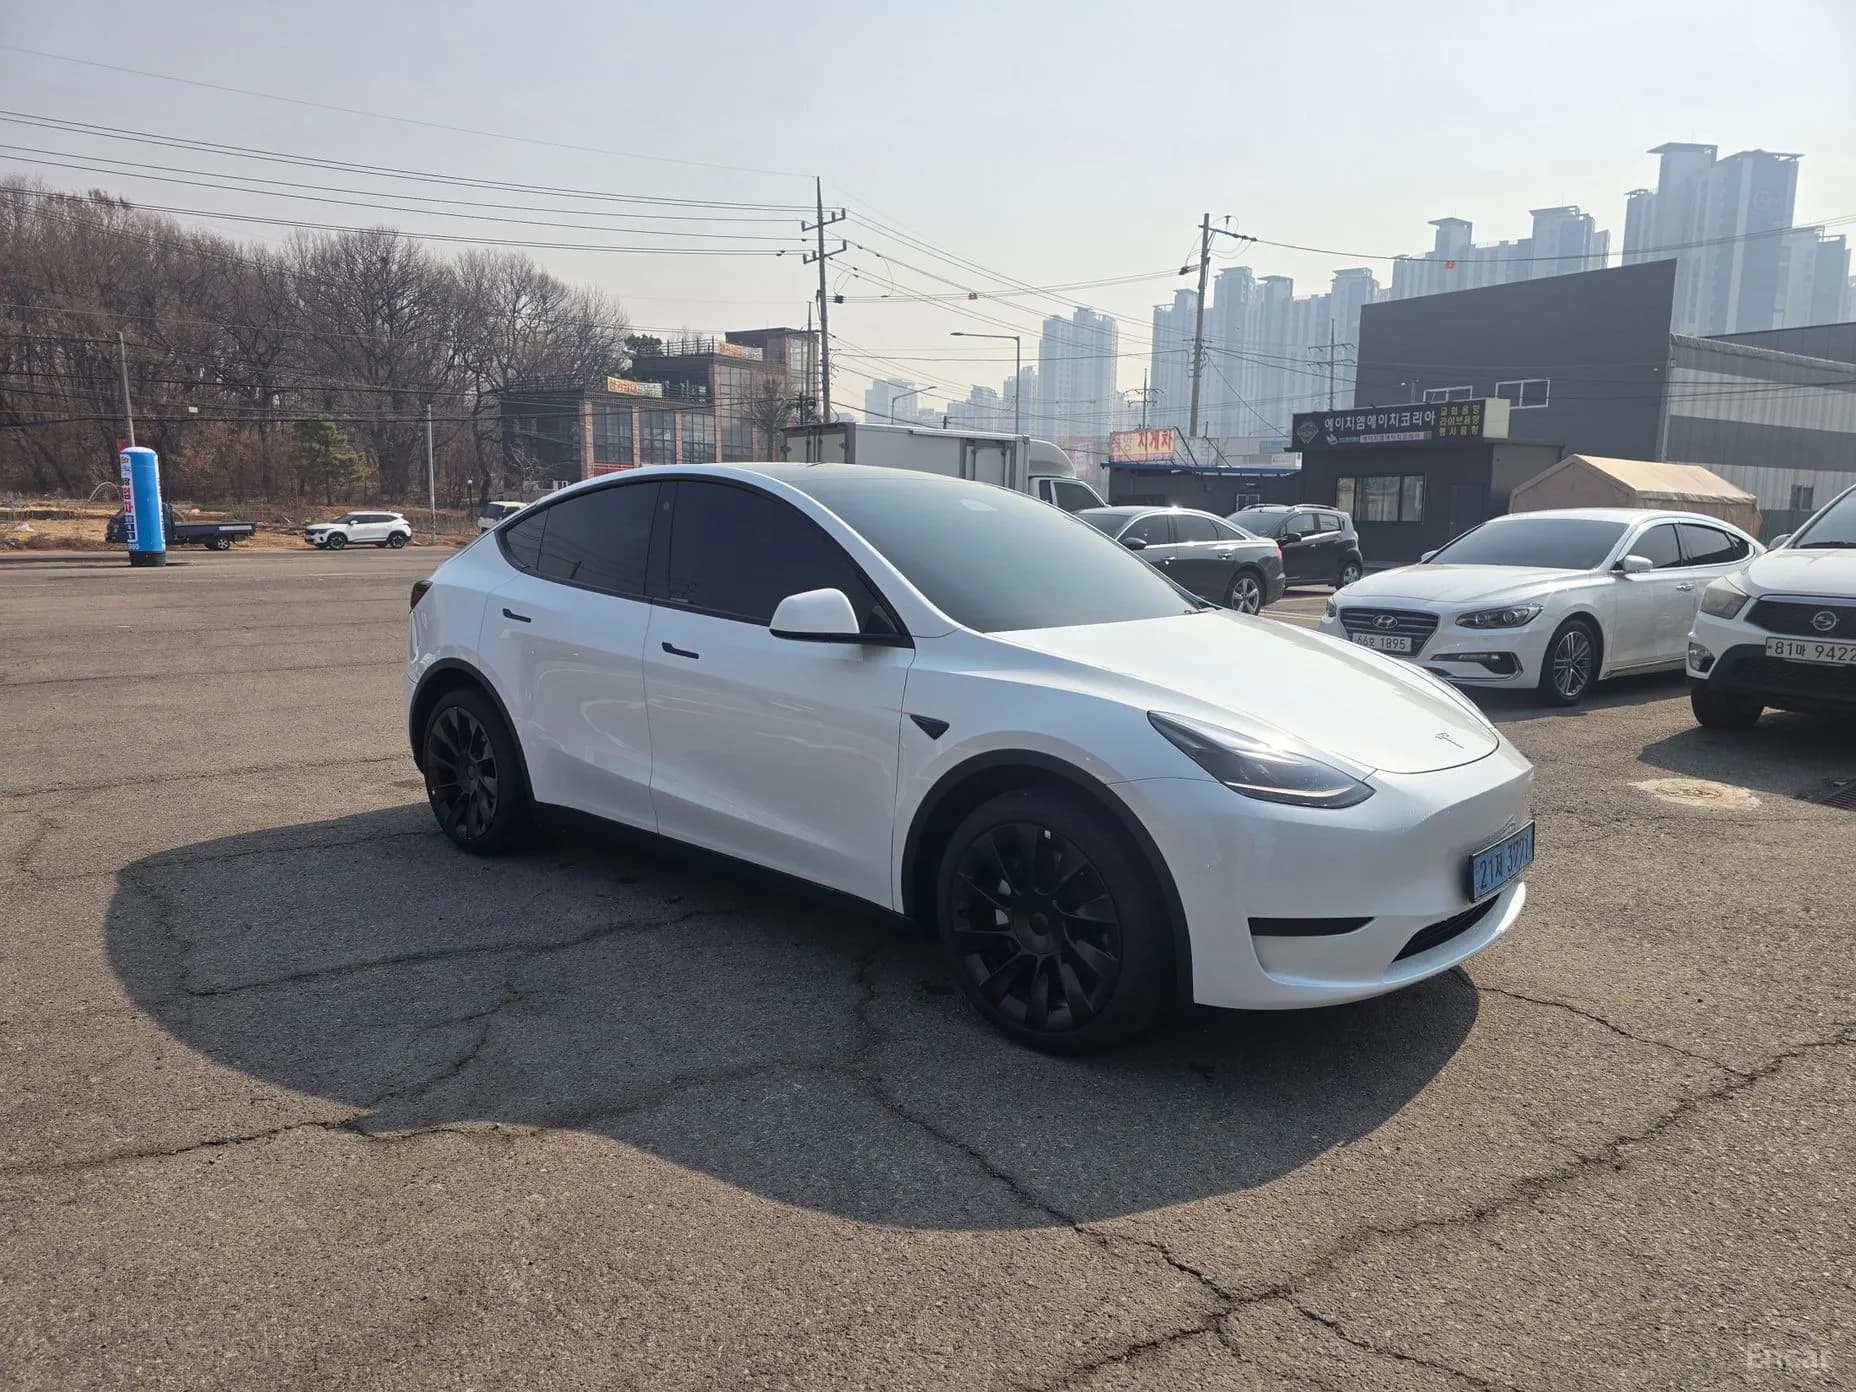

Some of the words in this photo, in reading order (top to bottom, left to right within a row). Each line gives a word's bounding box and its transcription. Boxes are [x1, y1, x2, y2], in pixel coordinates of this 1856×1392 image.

[1324, 410, 1436, 431] 에이치엠에이치코리아
[1138, 429, 1173, 451] 지게차
[1380, 637, 1406, 650] 1895
[1774, 641, 1806, 657] 81마
